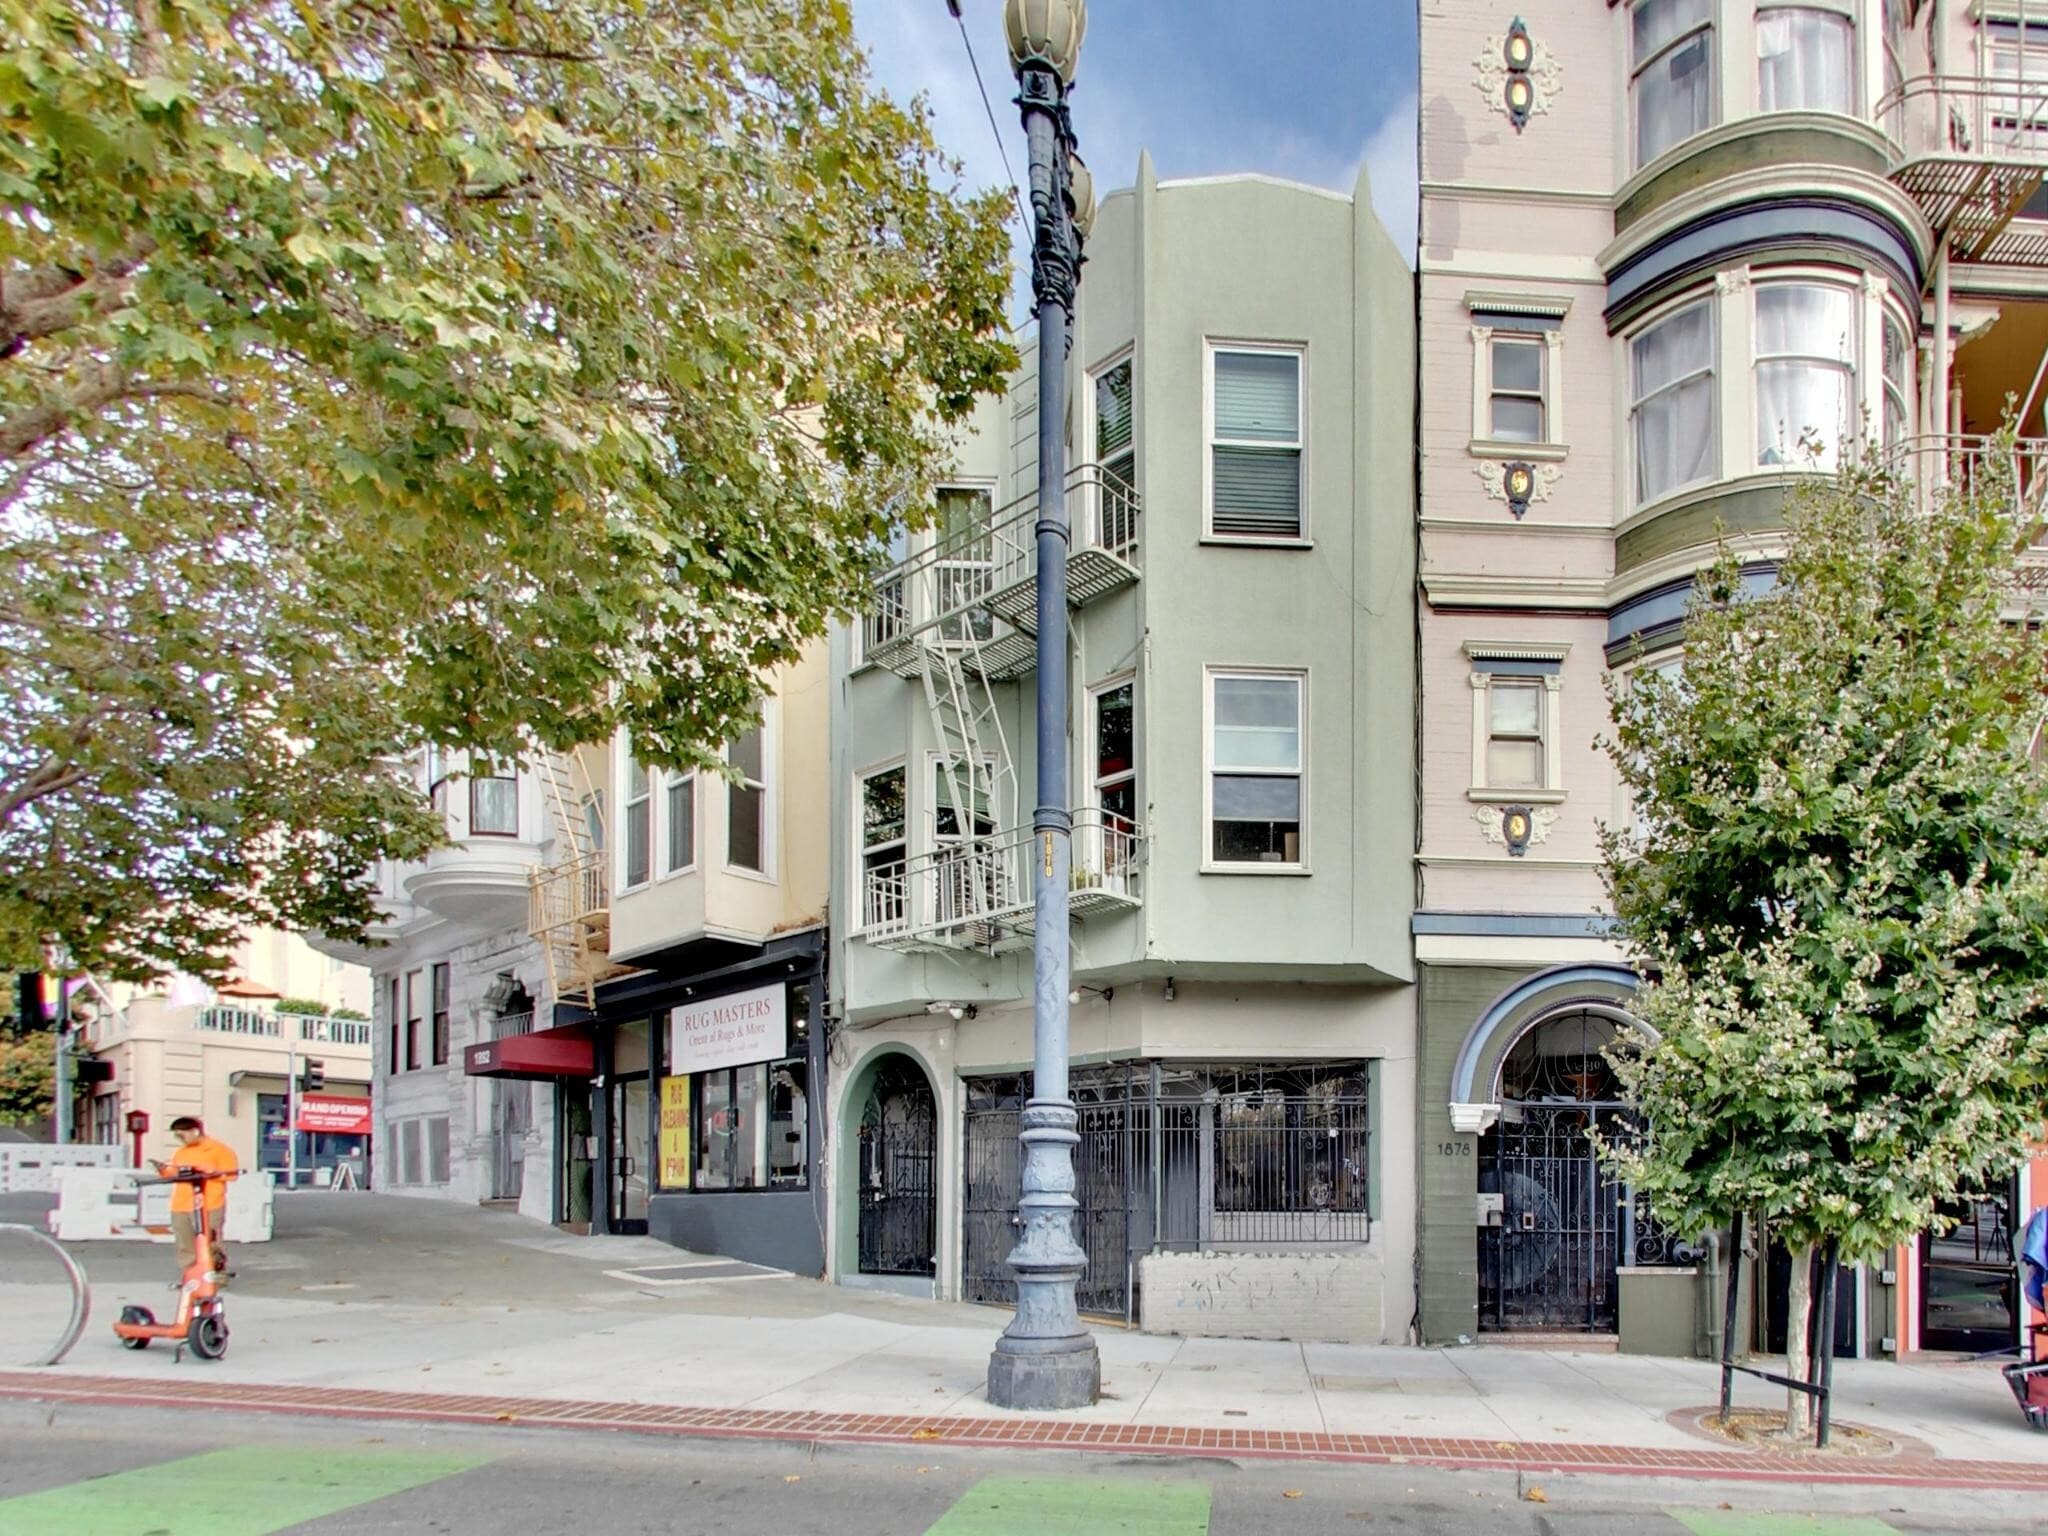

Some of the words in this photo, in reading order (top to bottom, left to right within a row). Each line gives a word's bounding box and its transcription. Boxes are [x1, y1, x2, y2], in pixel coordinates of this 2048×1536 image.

[684, 1011, 709, 1032] RUG
[713, 998, 771, 1026] MASTERS
[718, 1029, 736, 1043] Rugs
[737, 1026, 744, 1038] &
[746, 1022, 766, 1035] More
[671, 1084, 682, 1104] RUG
[1437, 1142, 1471, 1156] 1878
